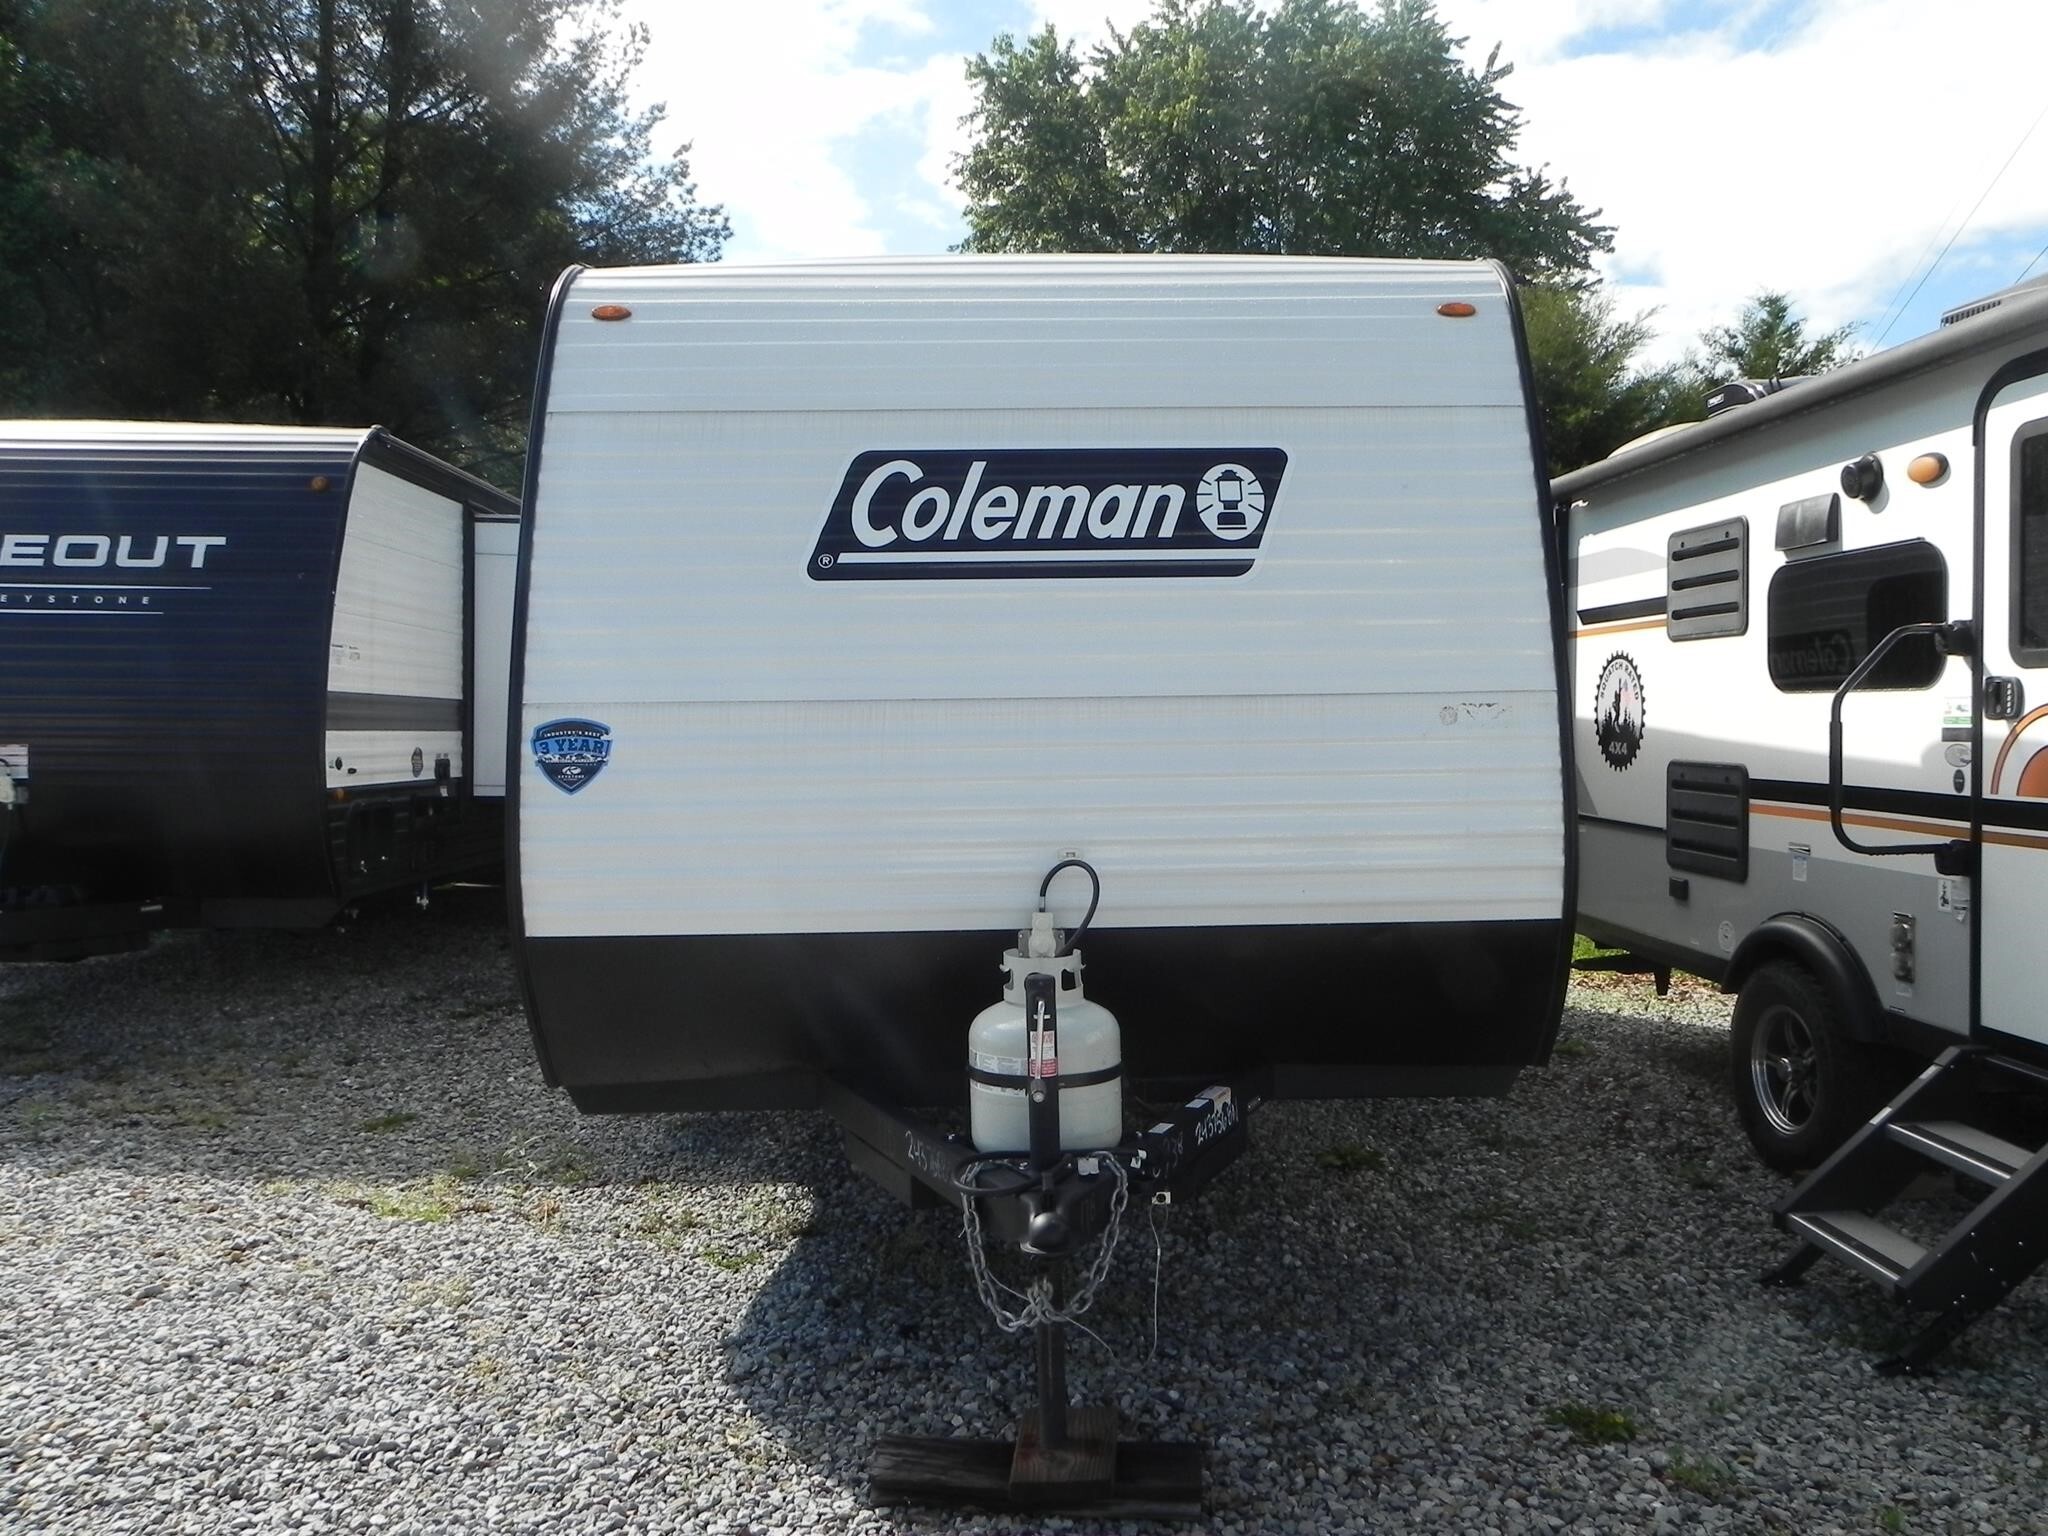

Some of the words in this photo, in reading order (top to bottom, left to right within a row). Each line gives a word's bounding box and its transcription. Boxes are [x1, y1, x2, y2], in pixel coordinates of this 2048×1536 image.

[852, 460, 1187, 548] Coleman
[0, 534, 227, 568] EOUT
[0, 594, 150, 605] EYSTONE
[1624, 662, 1639, 700] RATED
[555, 738, 605, 754] YEAR
